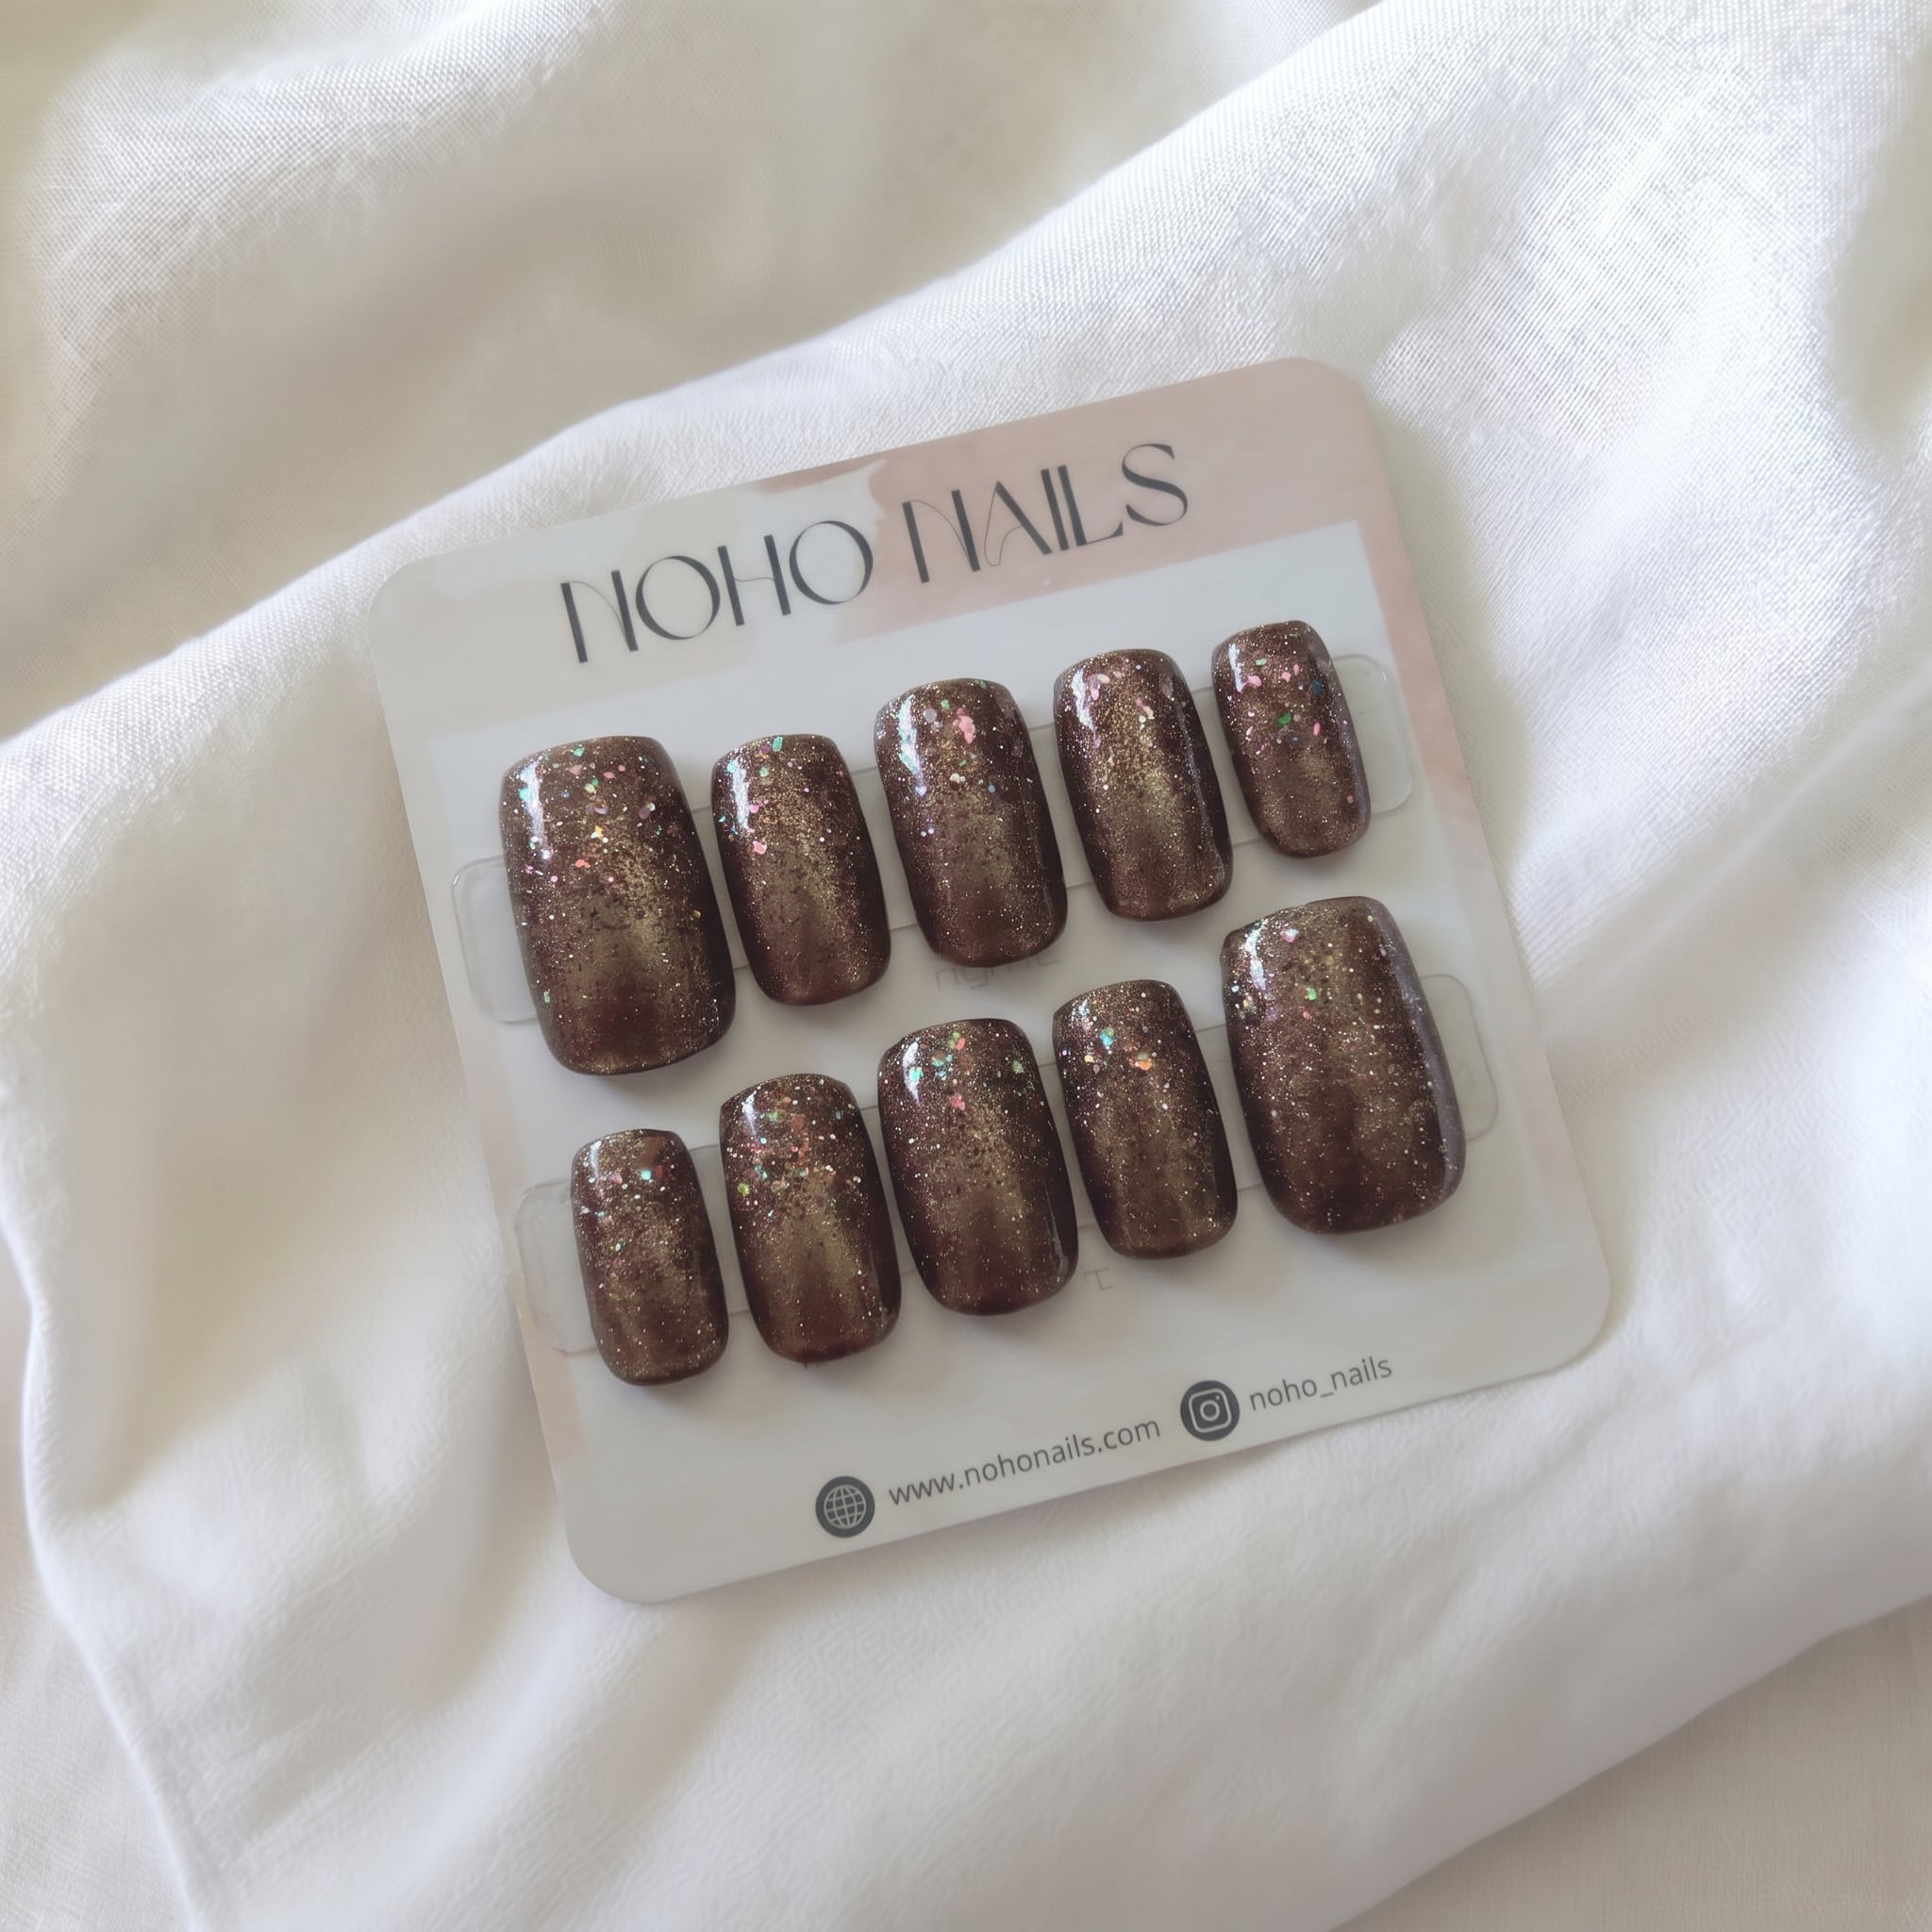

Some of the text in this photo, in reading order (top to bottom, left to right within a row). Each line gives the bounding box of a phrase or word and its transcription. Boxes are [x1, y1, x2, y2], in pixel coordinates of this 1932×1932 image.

[559, 442, 1189, 664] NOHO NAILS
[1247, 1356, 1393, 1413] noho_nails
[888, 1419, 1161, 1507] www.nohonails.com
